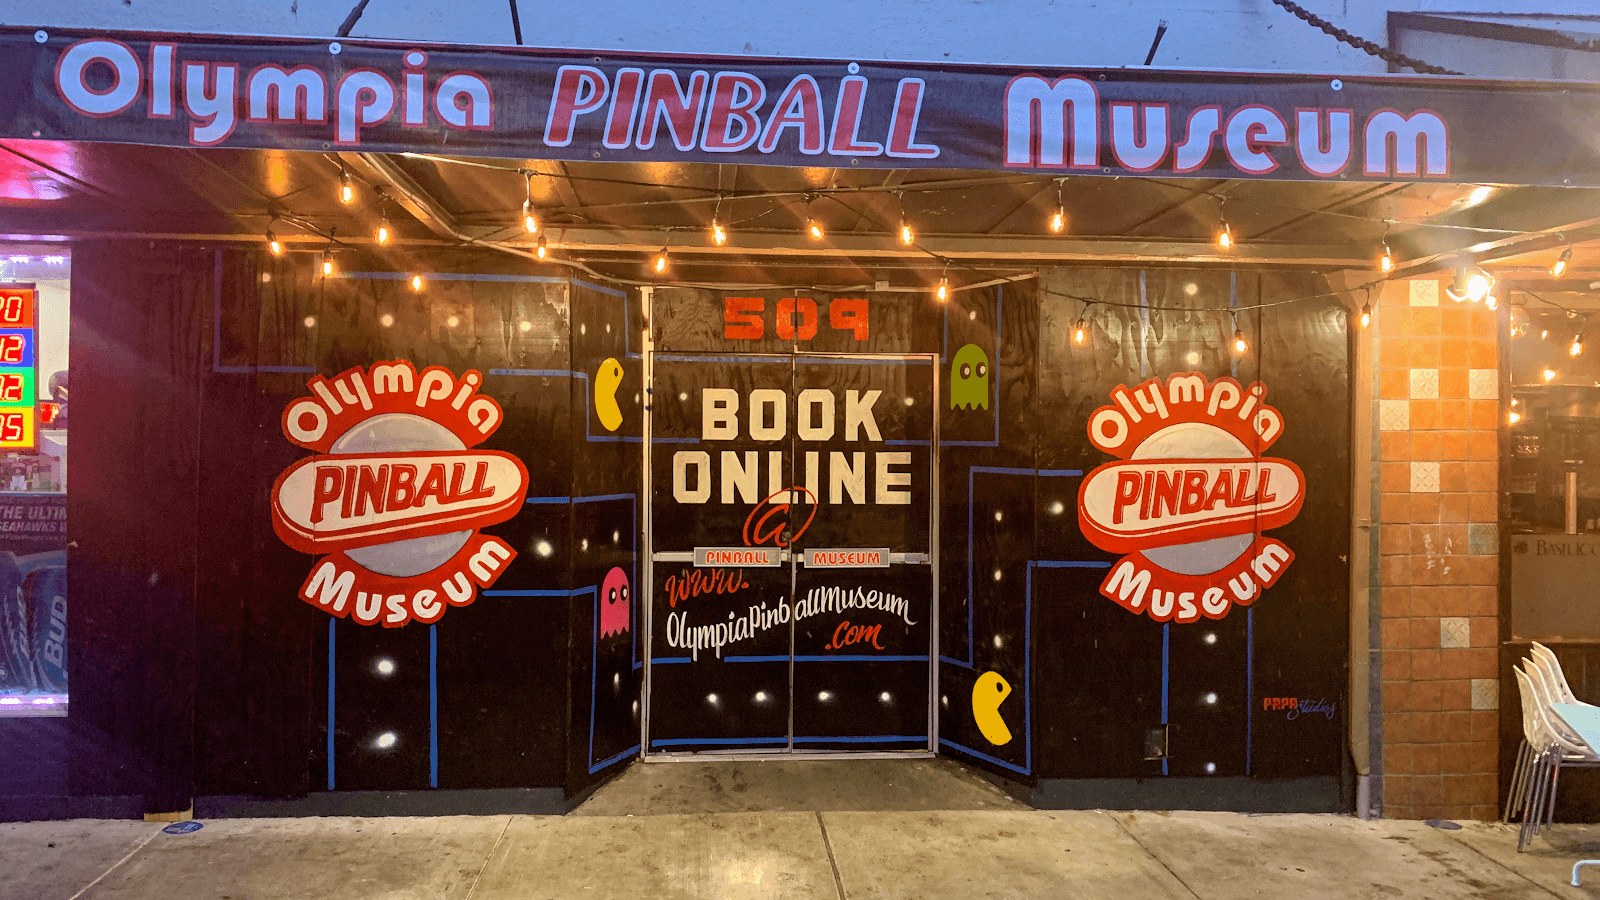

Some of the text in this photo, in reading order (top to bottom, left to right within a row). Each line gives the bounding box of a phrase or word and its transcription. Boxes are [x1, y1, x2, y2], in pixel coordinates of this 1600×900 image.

[54, 37, 1451, 178] Olympia PINBALL Museum
[724, 297, 869, 341] 509
[287, 363, 499, 443] Olympia
[702, 388, 883, 442] BOOK
[1091, 375, 1281, 448] Olympia
[310, 462, 496, 525] PINBALL
[672, 450, 912, 505] ONLINE
[1112, 468, 1277, 525] PINBALL
[304, 540, 511, 624] Museum
[705, 550, 881, 566] PINBALL MUSEUM
[1105, 543, 1290, 619] Museum
[44, 595, 68, 669] BUD
